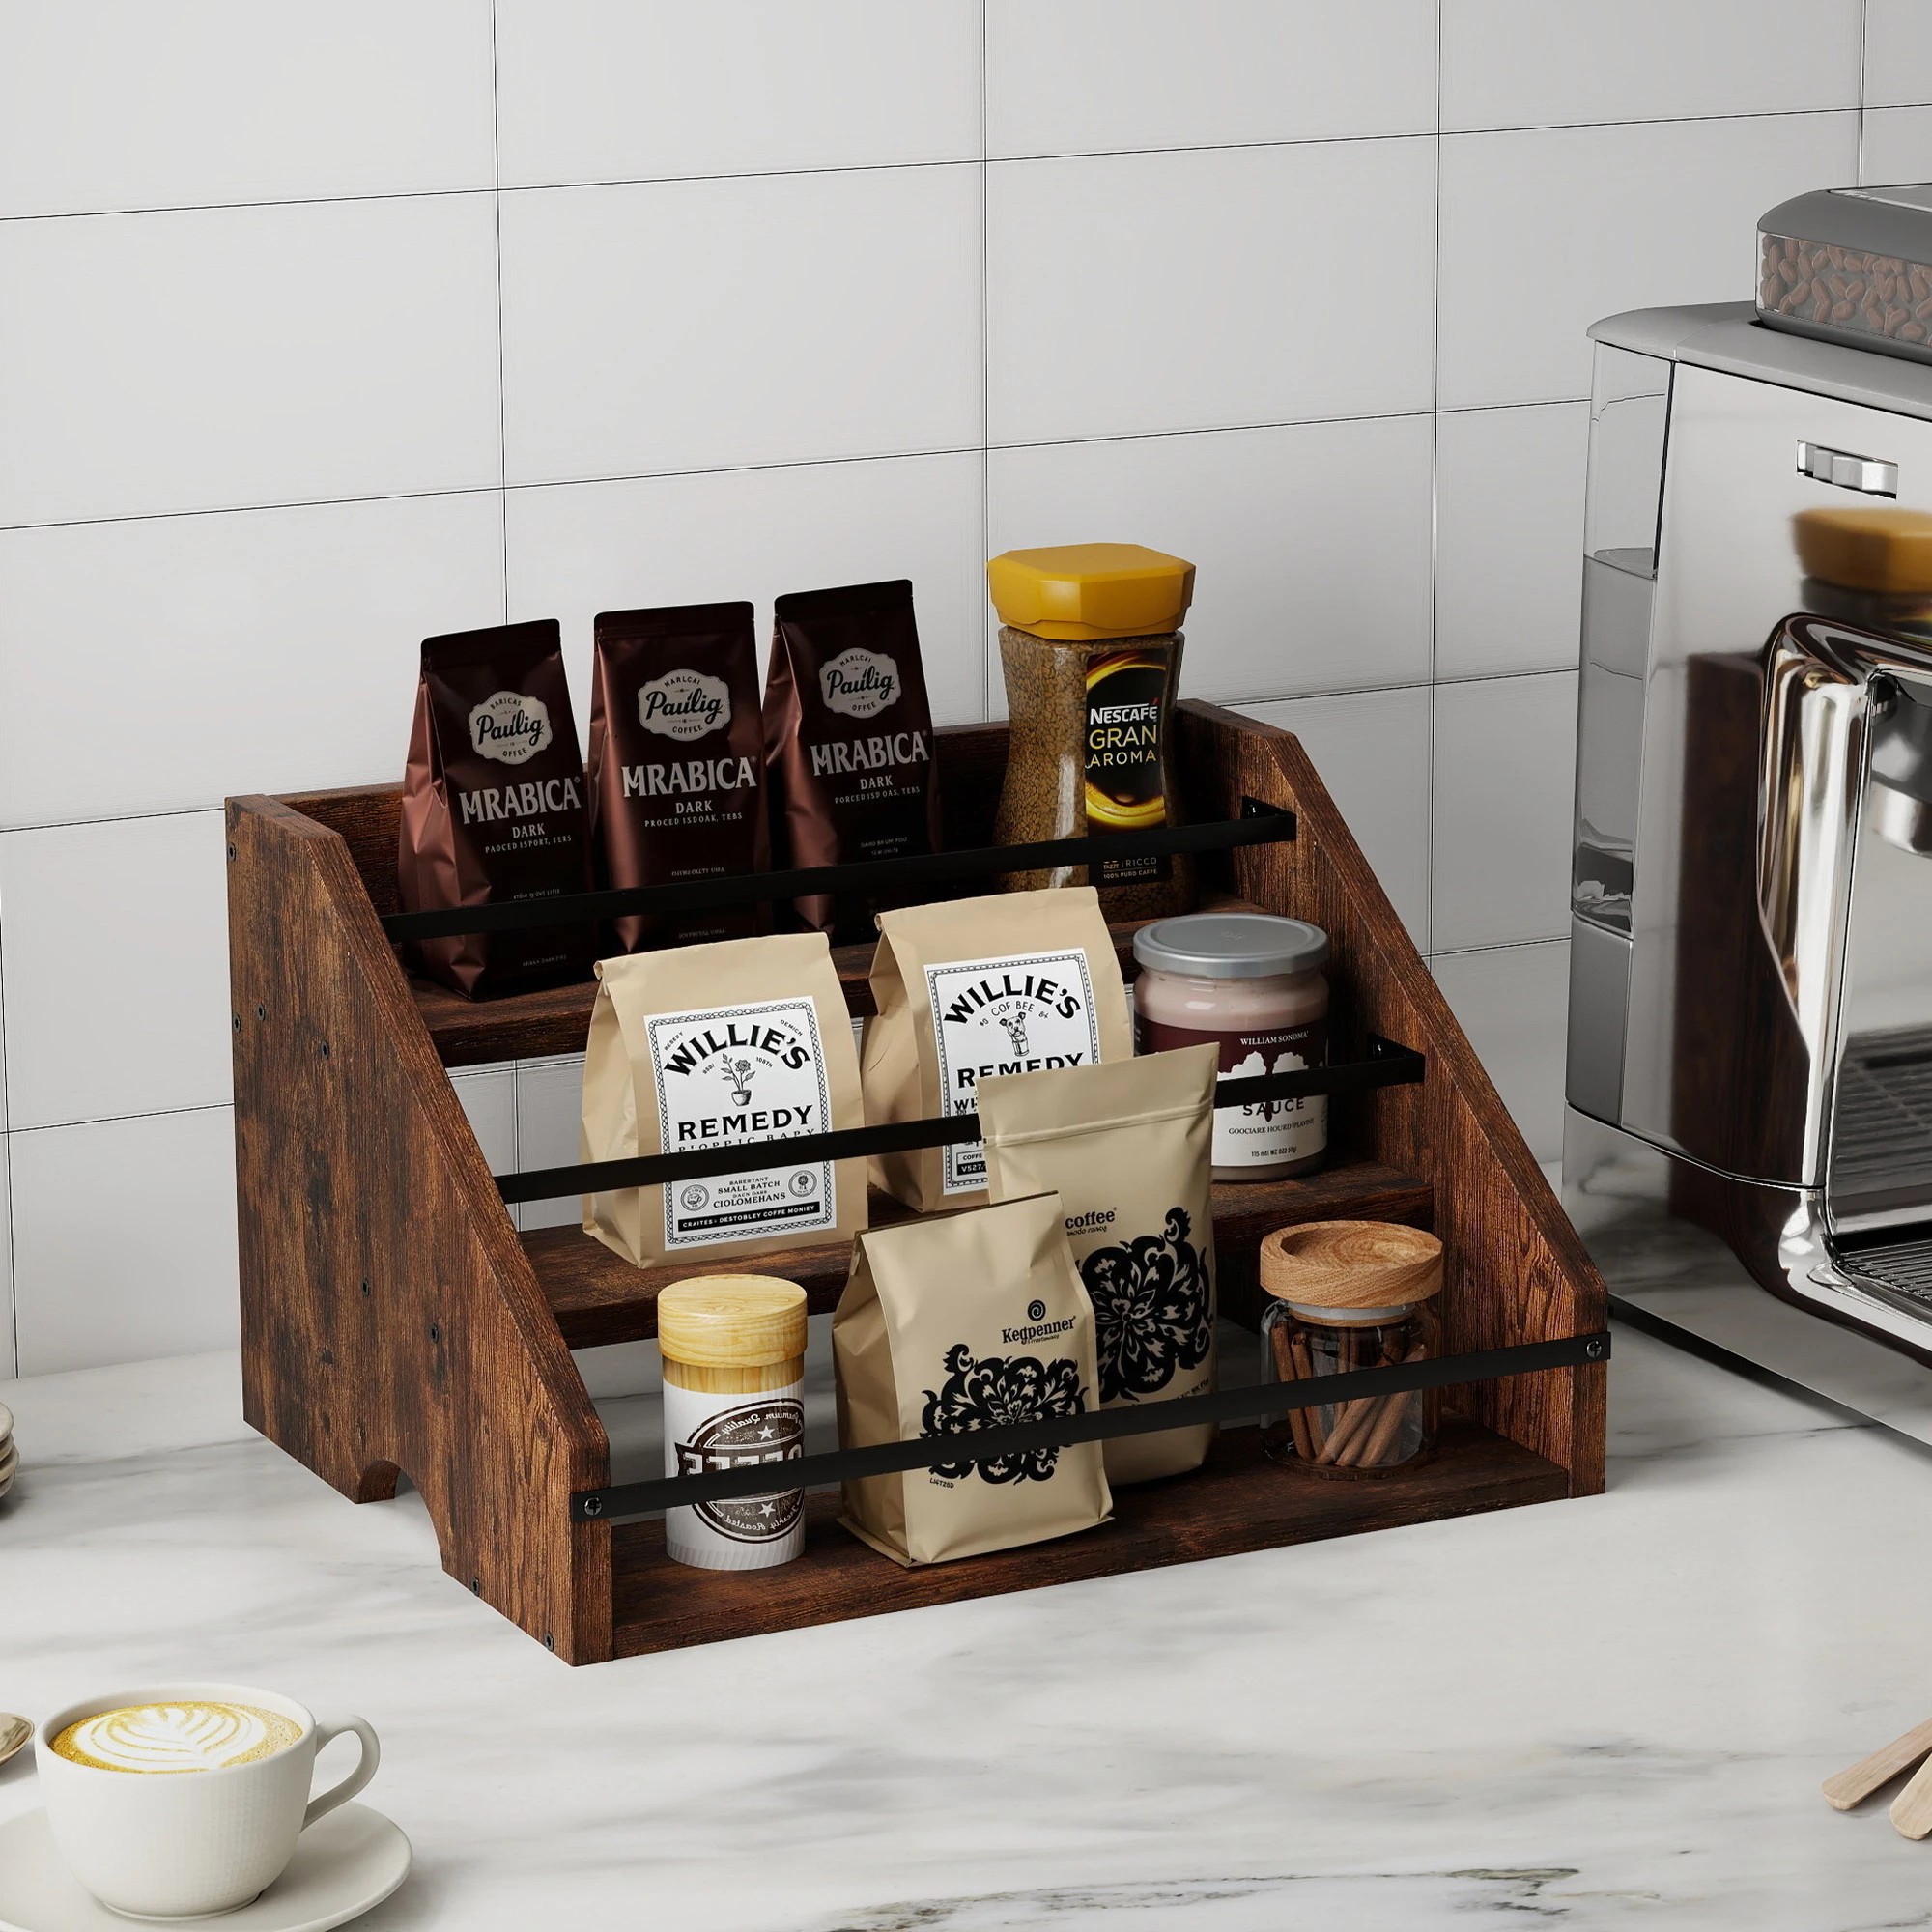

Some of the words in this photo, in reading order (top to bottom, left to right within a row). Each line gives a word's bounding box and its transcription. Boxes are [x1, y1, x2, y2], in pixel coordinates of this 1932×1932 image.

[827, 666, 895, 700] Paulig
[645, 687, 723, 724] Paulig
[476, 709, 544, 746] Paulig
[672, 724, 703, 734] COFFEE
[1089, 724, 1157, 750] GRAN
[810, 731, 929, 777] MRABICA
[1085, 750, 1156, 769] AROMA
[621, 757, 757, 797] MRABICA
[860, 775, 894, 790] DARK
[459, 777, 582, 825] MRABICA
[675, 800, 713, 814] DARK
[512, 823, 546, 838] DARK
[1125, 857, 1157, 867] RICCO
[944, 974, 1081, 1024] WILLIE'S
[991, 1001, 1011, 1016] COF
[663, 1023, 811, 1076] WILLIE'S
[1240, 1036, 1277, 1045] WILLIAM
[1242, 1097, 1304, 1116] SAUCE
[677, 1104, 813, 1141] REMEDY
[718, 1184, 748, 1194] SMALL
[751, 1180, 781, 1190] BATCH
[1065, 1210, 1116, 1229] coffee
